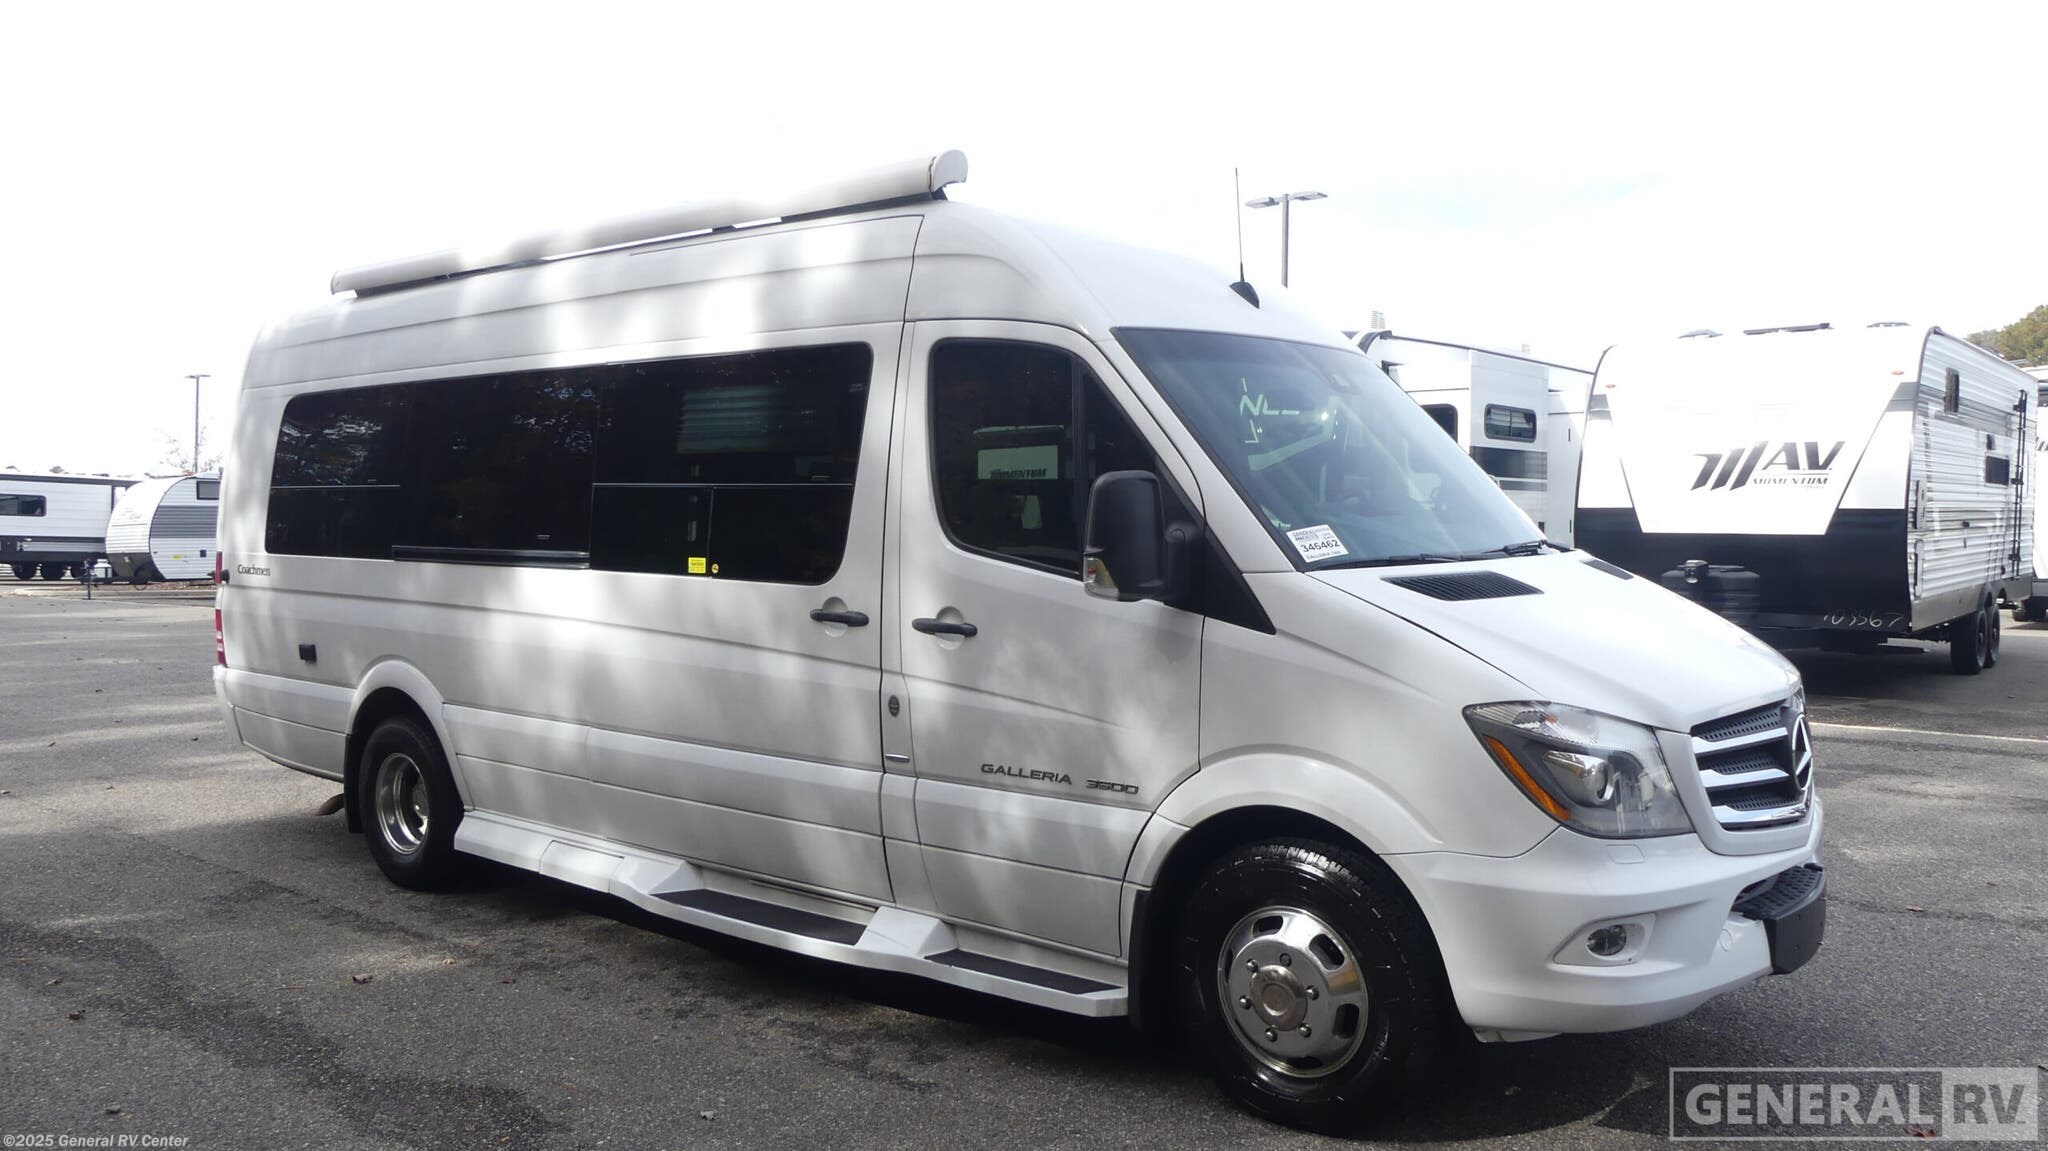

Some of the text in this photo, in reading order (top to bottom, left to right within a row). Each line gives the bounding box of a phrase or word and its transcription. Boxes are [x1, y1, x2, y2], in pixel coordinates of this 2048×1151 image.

[1301, 539, 1341, 553] 346462
[237, 563, 271, 577] Coachmen
[981, 763, 1139, 795] GALLERIA 3500
